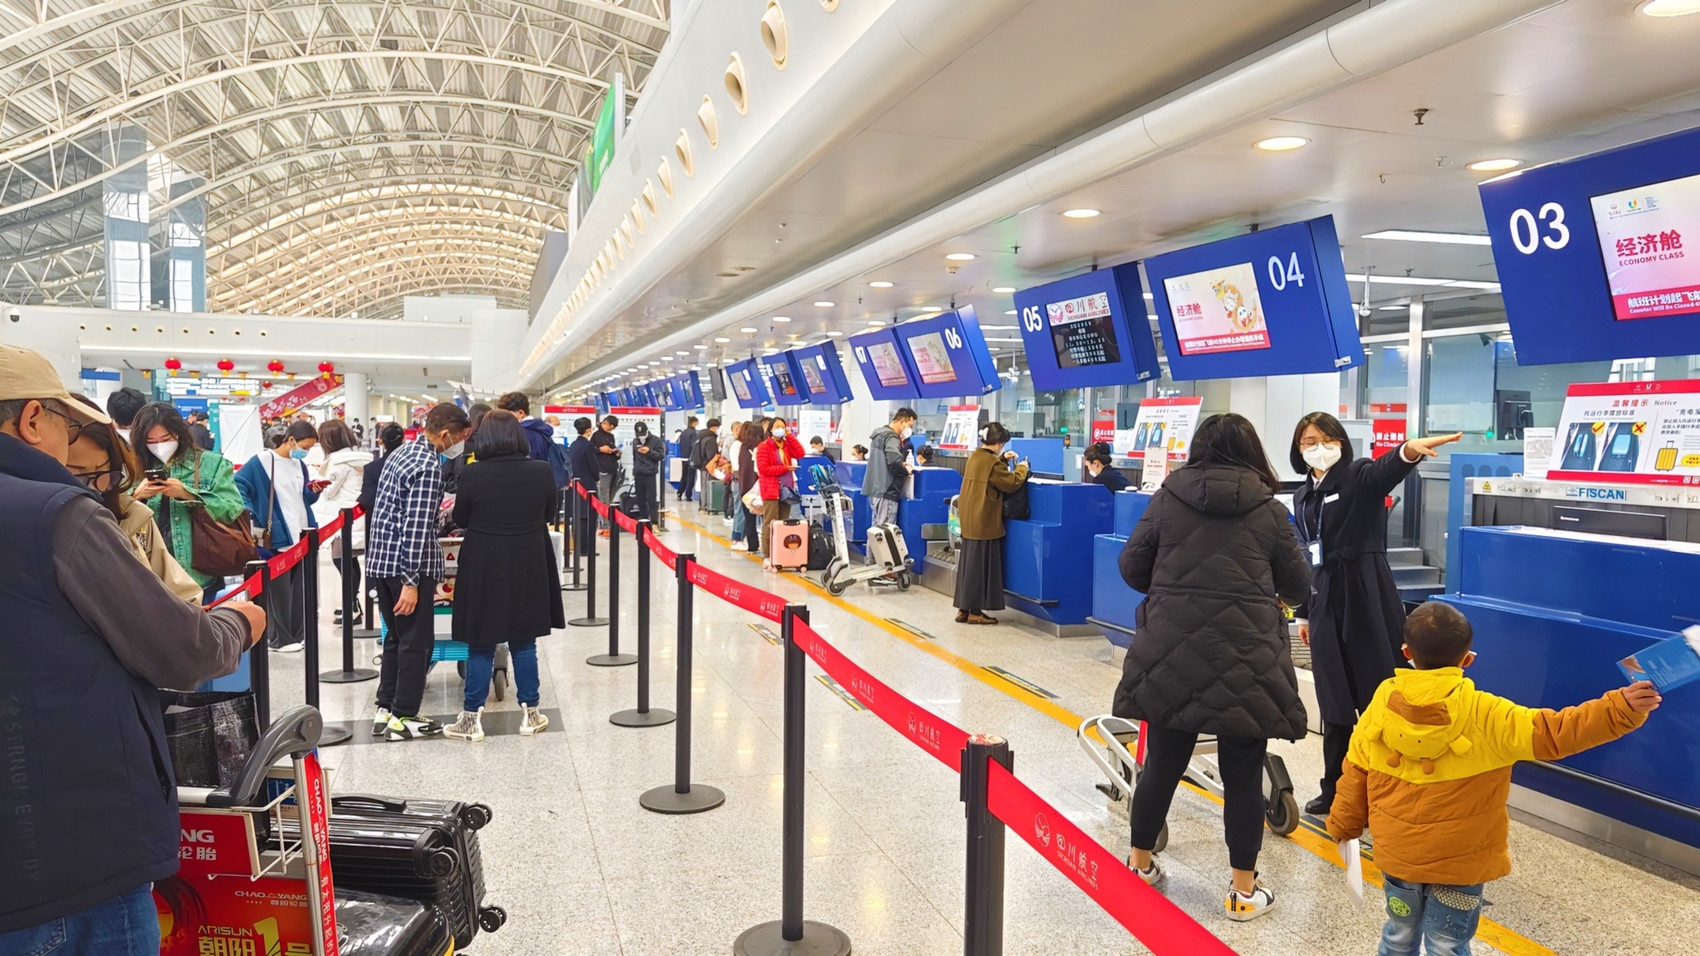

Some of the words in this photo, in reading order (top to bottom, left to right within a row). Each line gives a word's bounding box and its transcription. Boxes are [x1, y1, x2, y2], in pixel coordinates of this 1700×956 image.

[1510, 202, 1570, 254] 03
[1615, 229, 1683, 257] 经济舱
[1619, 256, 1657, 266] ECONOMY
[1659, 251, 1684, 260] CLASS
[1268, 252, 1304, 290] 04
[1023, 306, 1043, 332] 05
[1177, 303, 1202, 317] 经济舱
[945, 327, 962, 349] 06
[1578, 487, 1624, 500] FISCAN
[314, 778, 323, 815] CHAO
[320, 825, 328, 862] YANG
[180, 830, 215, 843] NG
[1056, 833, 1099, 882] 四川航空
[235, 890, 266, 898] CHAO
[277, 893, 308, 901] YANG
[198, 925, 253, 937] ARISUN
